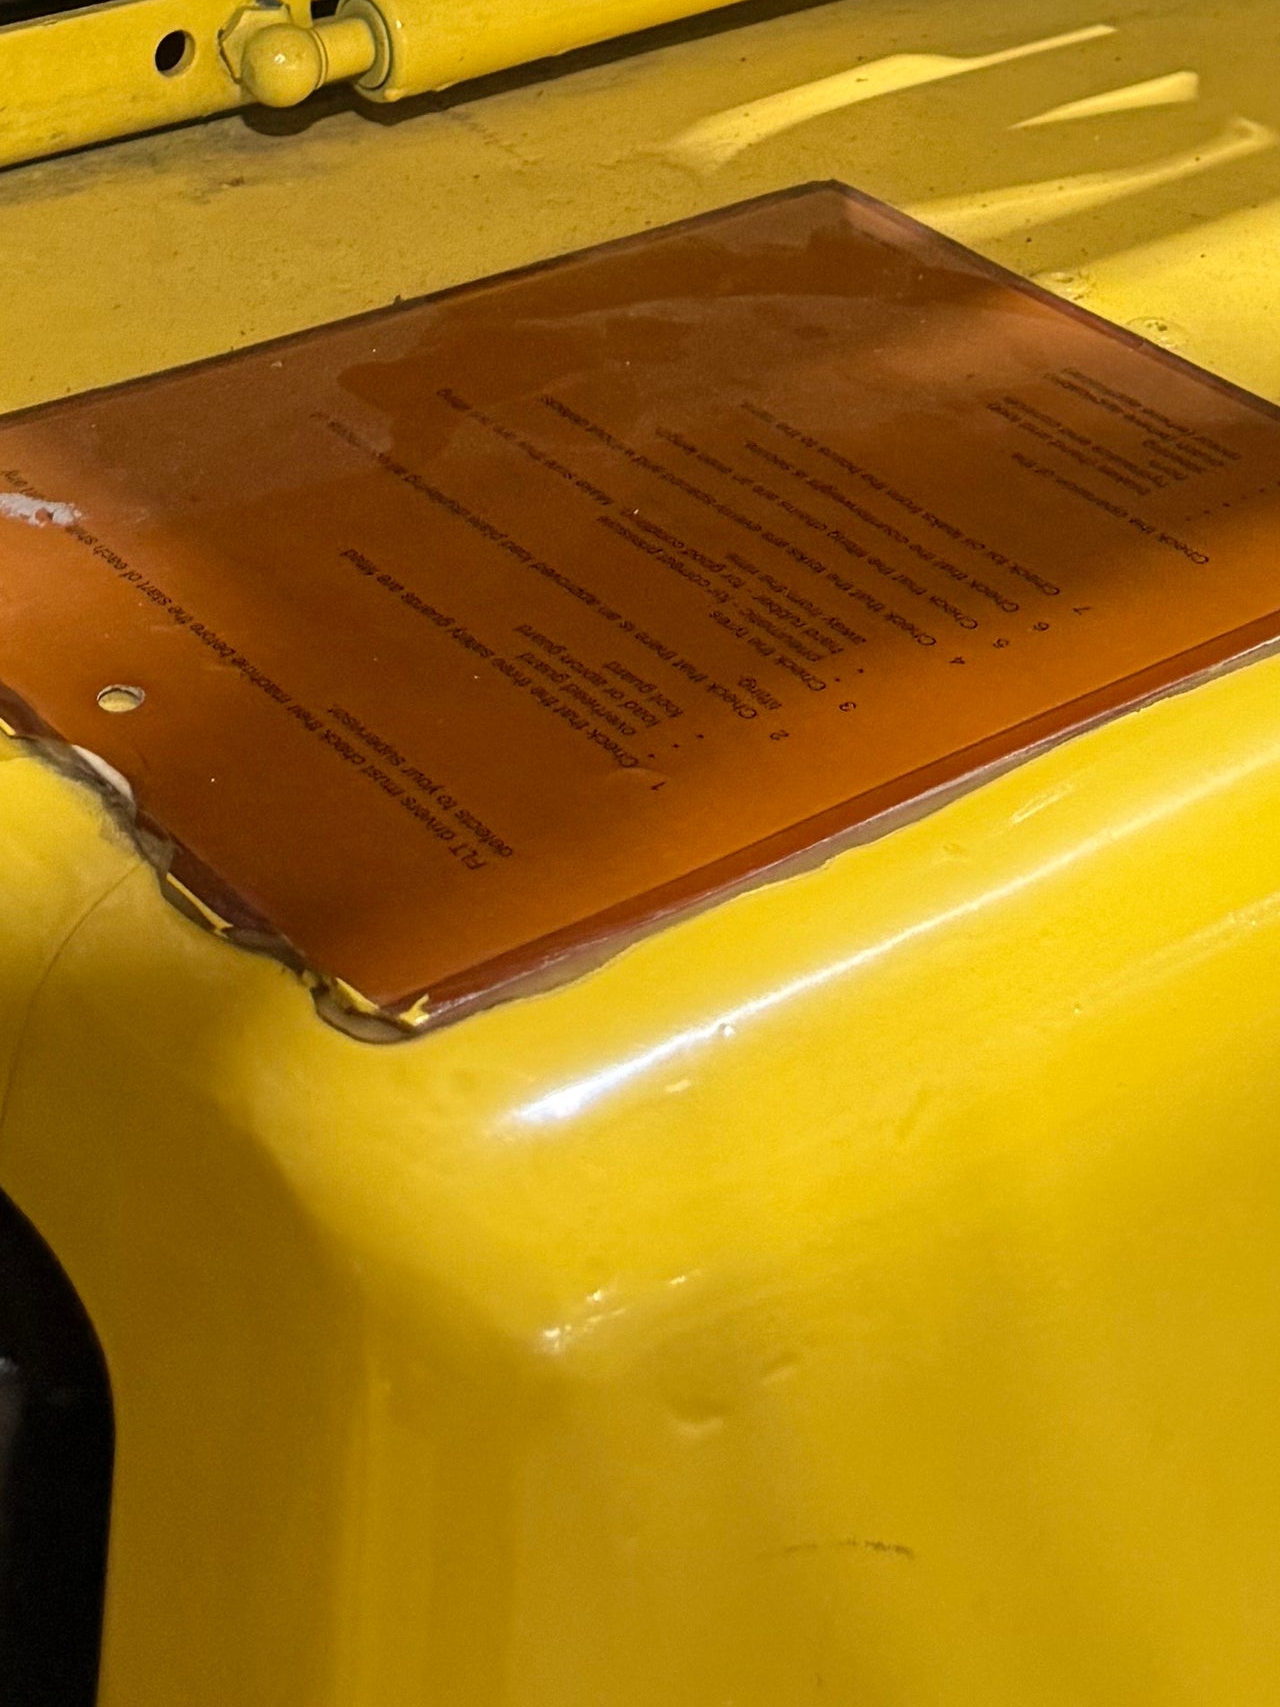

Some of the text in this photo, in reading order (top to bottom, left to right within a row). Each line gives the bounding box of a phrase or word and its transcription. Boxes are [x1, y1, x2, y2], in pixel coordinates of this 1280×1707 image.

[92, 544, 128, 570] each
[1156, 532, 1209, 565] Check
[967, 580, 1020, 613] Check
[1009, 564, 1060, 596] Check
[400, 592, 454, 627] guards
[928, 595, 978, 630] Check
[189, 623, 235, 658] before
[446, 627, 494, 658] safety
[514, 624, 566, 654] guard
[634, 631, 676, 660] there
[884, 612, 936, 646] Check
[229, 657, 290, 703] machine
[491, 658, 531, 687] three
[559, 655, 607, 685] apron
[602, 661, 656, 693] guard
[774, 656, 826, 691] Check
[516, 652, 636, 736] overhead guard
[706, 683, 758, 719] Check
[286, 705, 322, 731] their
[619, 700, 660, 728] load
[318, 730, 365, 765] check
[586, 729, 640, 768] Check
[359, 765, 403, 796] must
[401, 767, 443, 794] your
[400, 797, 455, 840] drivers
[454, 810, 513, 857] defects
[448, 844, 487, 870] FLT
